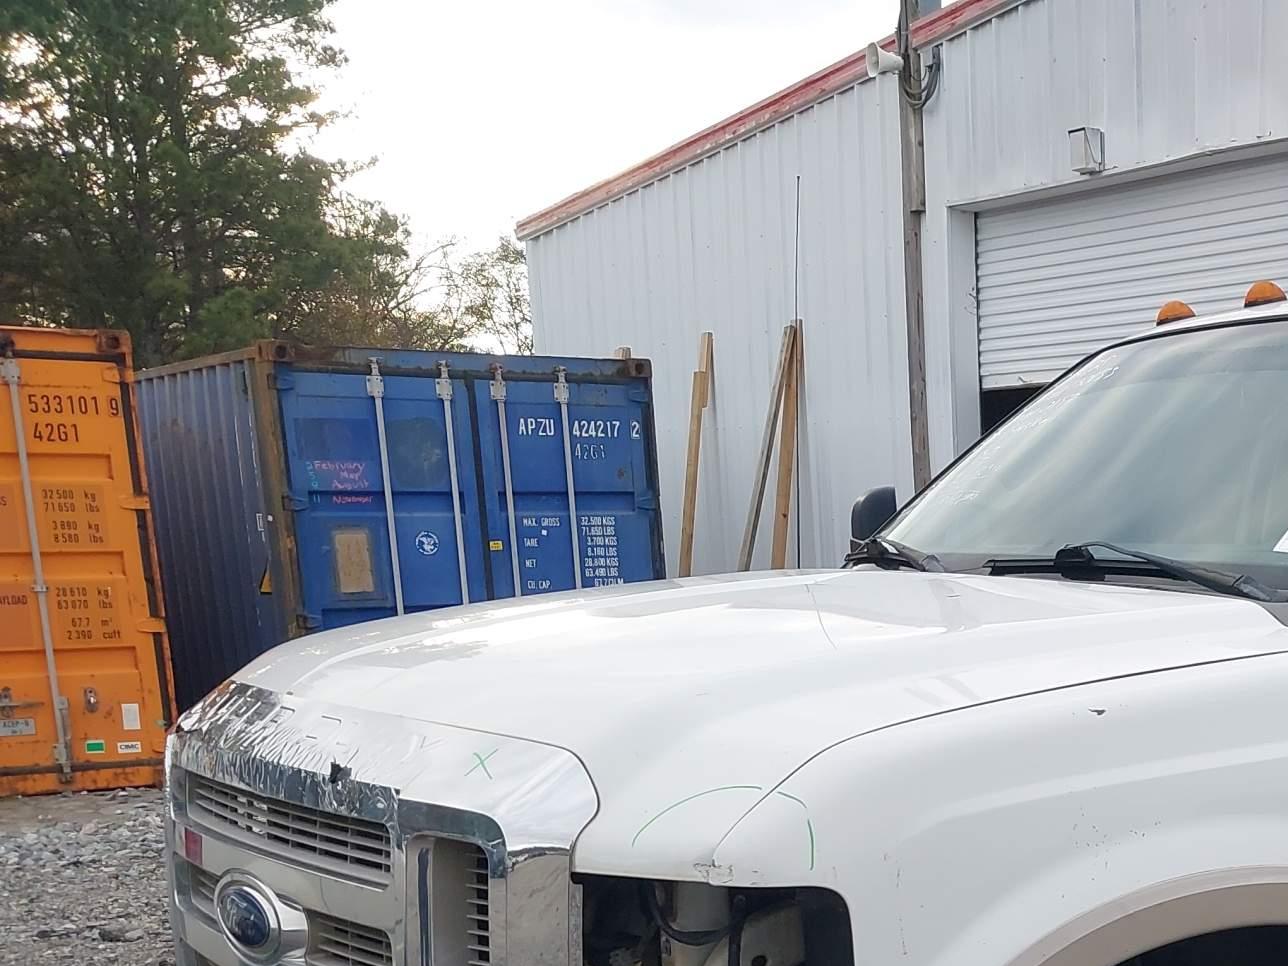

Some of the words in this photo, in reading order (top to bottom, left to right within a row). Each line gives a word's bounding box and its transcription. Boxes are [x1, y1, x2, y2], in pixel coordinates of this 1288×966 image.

[28, 394, 99, 415] 533101
[109, 398, 119, 416] 9
[33, 422, 79, 443] 42G1
[519, 418, 555, 436] APZU
[572, 420, 620, 438] 424217
[631, 421, 640, 438] 2
[313, 460, 365, 471] February
[84, 491, 96, 502] kg
[85, 502, 100, 512] lbs
[87, 521, 100, 533] kg
[541, 518, 560, 527] GROSS
[602, 517, 615, 526] KGS
[603, 527, 615, 535] LBS
[89, 534, 104, 544] lbs
[524, 538, 538, 547] TARE
[605, 537, 618, 546] KGS
[605, 548, 617, 556] LBS
[525, 559, 536, 568] NET
[606, 557, 619, 567] KGS
[97, 587, 109, 599] kg
[99, 599, 112, 609] lbs
